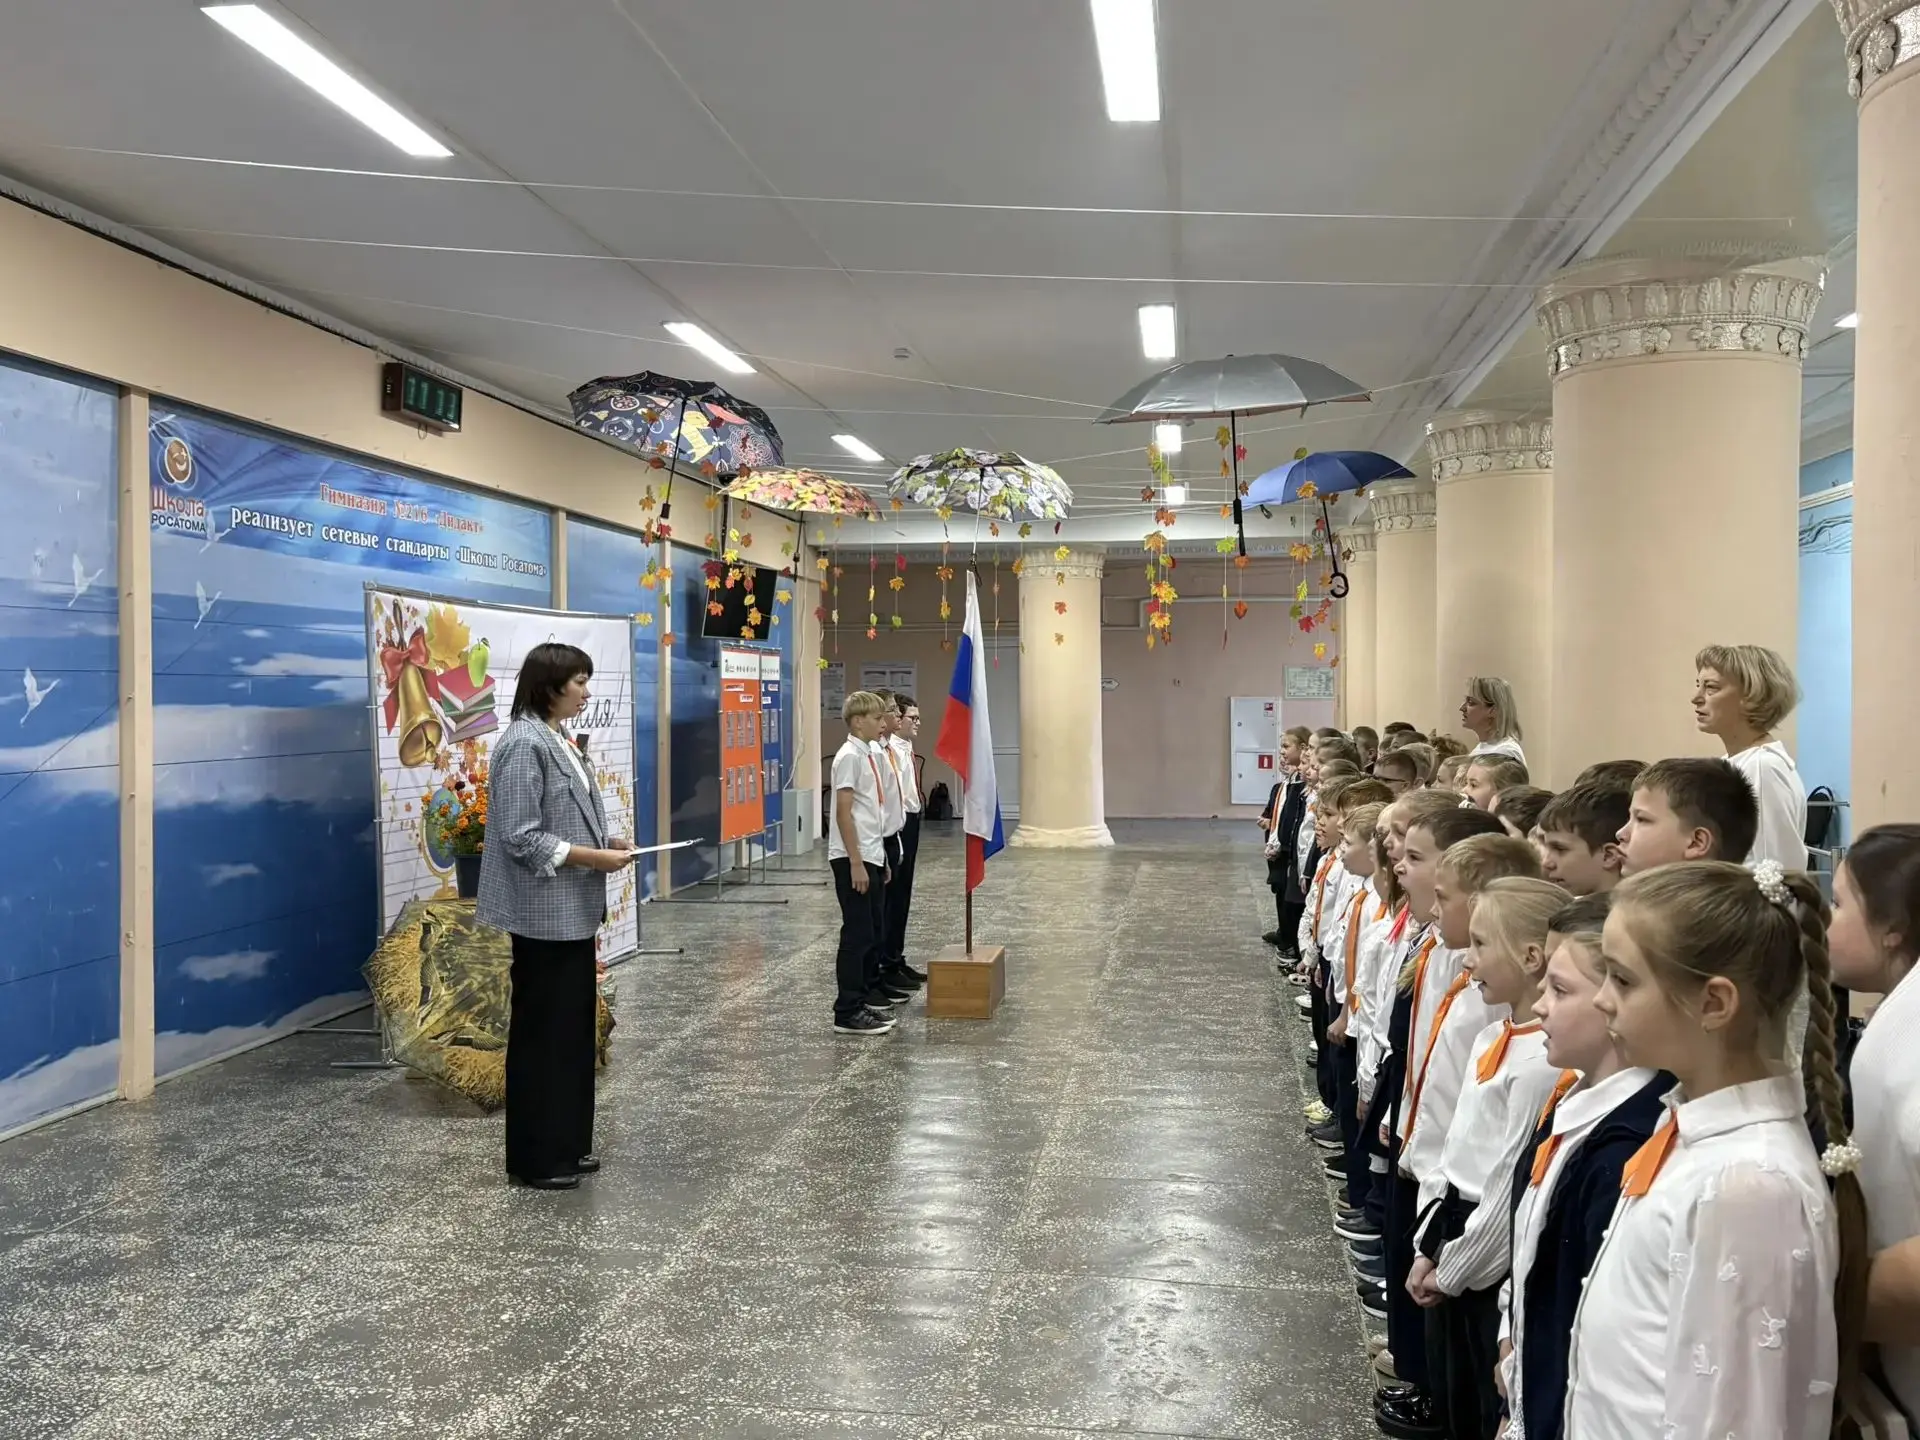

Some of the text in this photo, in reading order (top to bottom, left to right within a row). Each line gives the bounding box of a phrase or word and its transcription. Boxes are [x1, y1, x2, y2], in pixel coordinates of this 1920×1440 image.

[152, 485, 205, 518] Школа
[320, 482, 388, 516] Гимназия
[393, 499, 428, 524] №216
[151, 513, 206, 532] РОСАТОМА
[231, 506, 547, 577] реализует сетевые стандарты «Школы Росатома»
